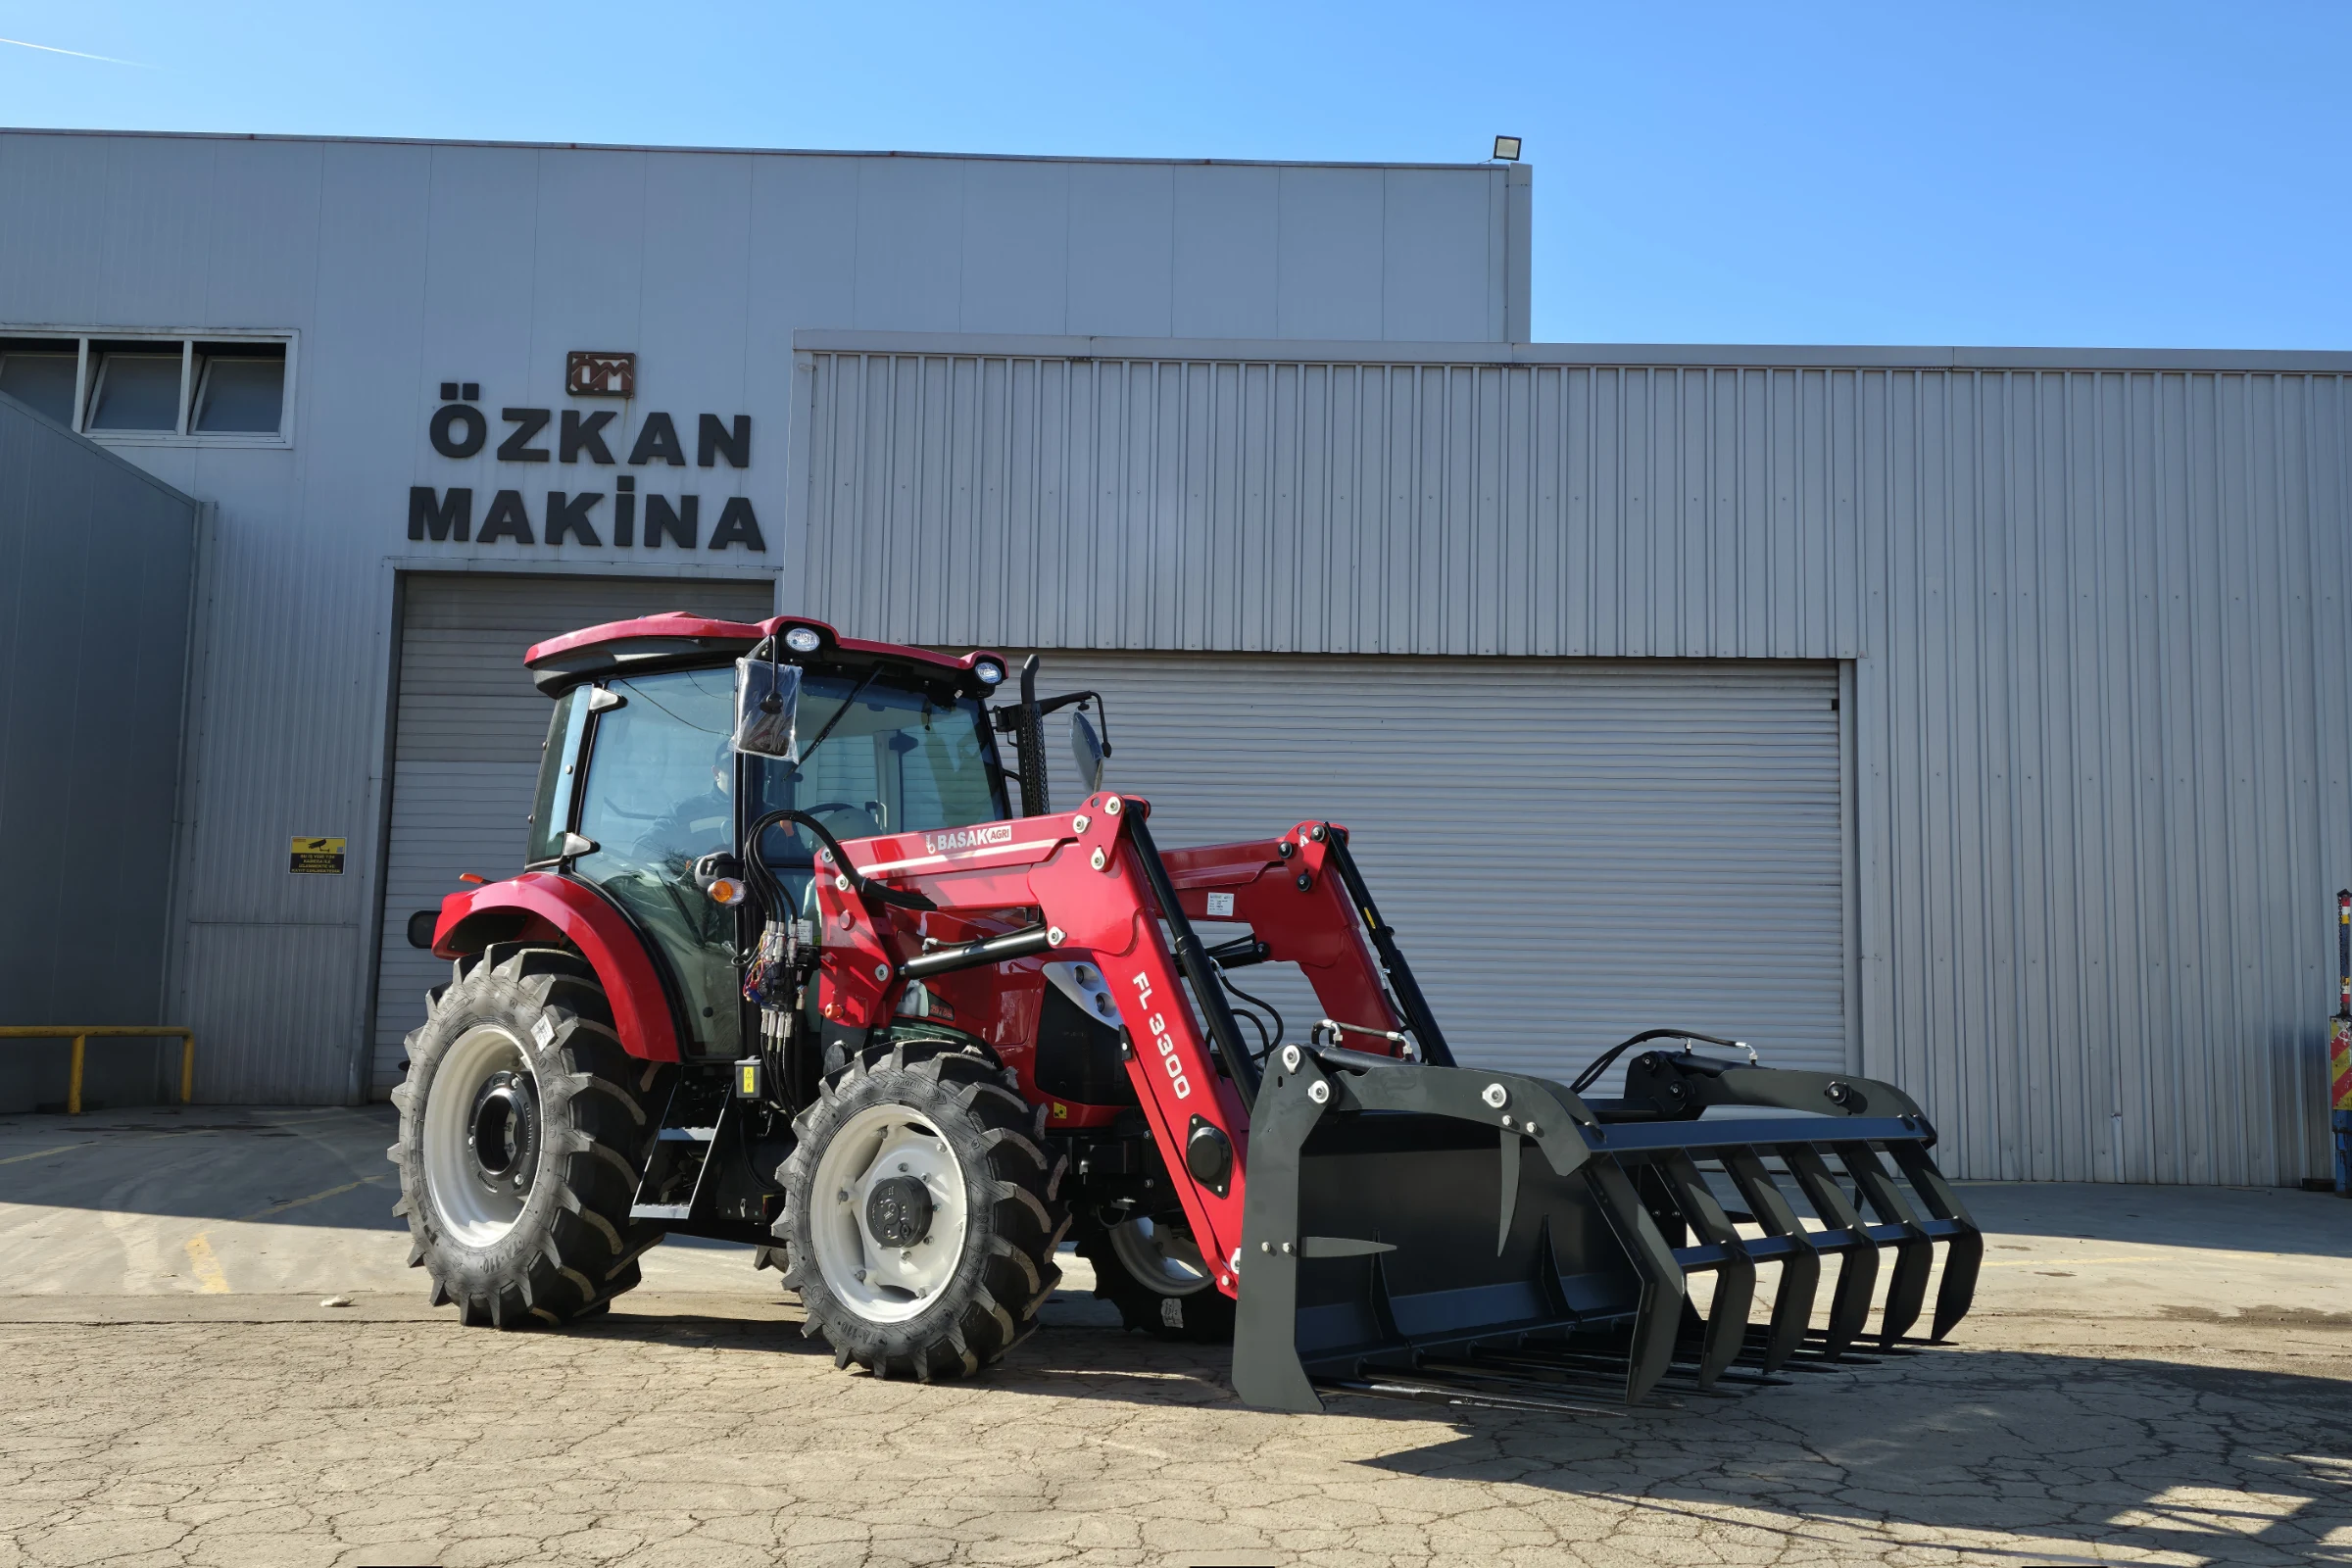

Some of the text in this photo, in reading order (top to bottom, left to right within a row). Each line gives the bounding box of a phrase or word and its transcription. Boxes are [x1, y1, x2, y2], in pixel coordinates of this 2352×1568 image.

[428, 382, 752, 468] ÖZKAN
[407, 474, 766, 552] MAKİNA
[990, 828, 1009, 841] AGRI
[1133, 970, 1191, 1100] FL 3300
